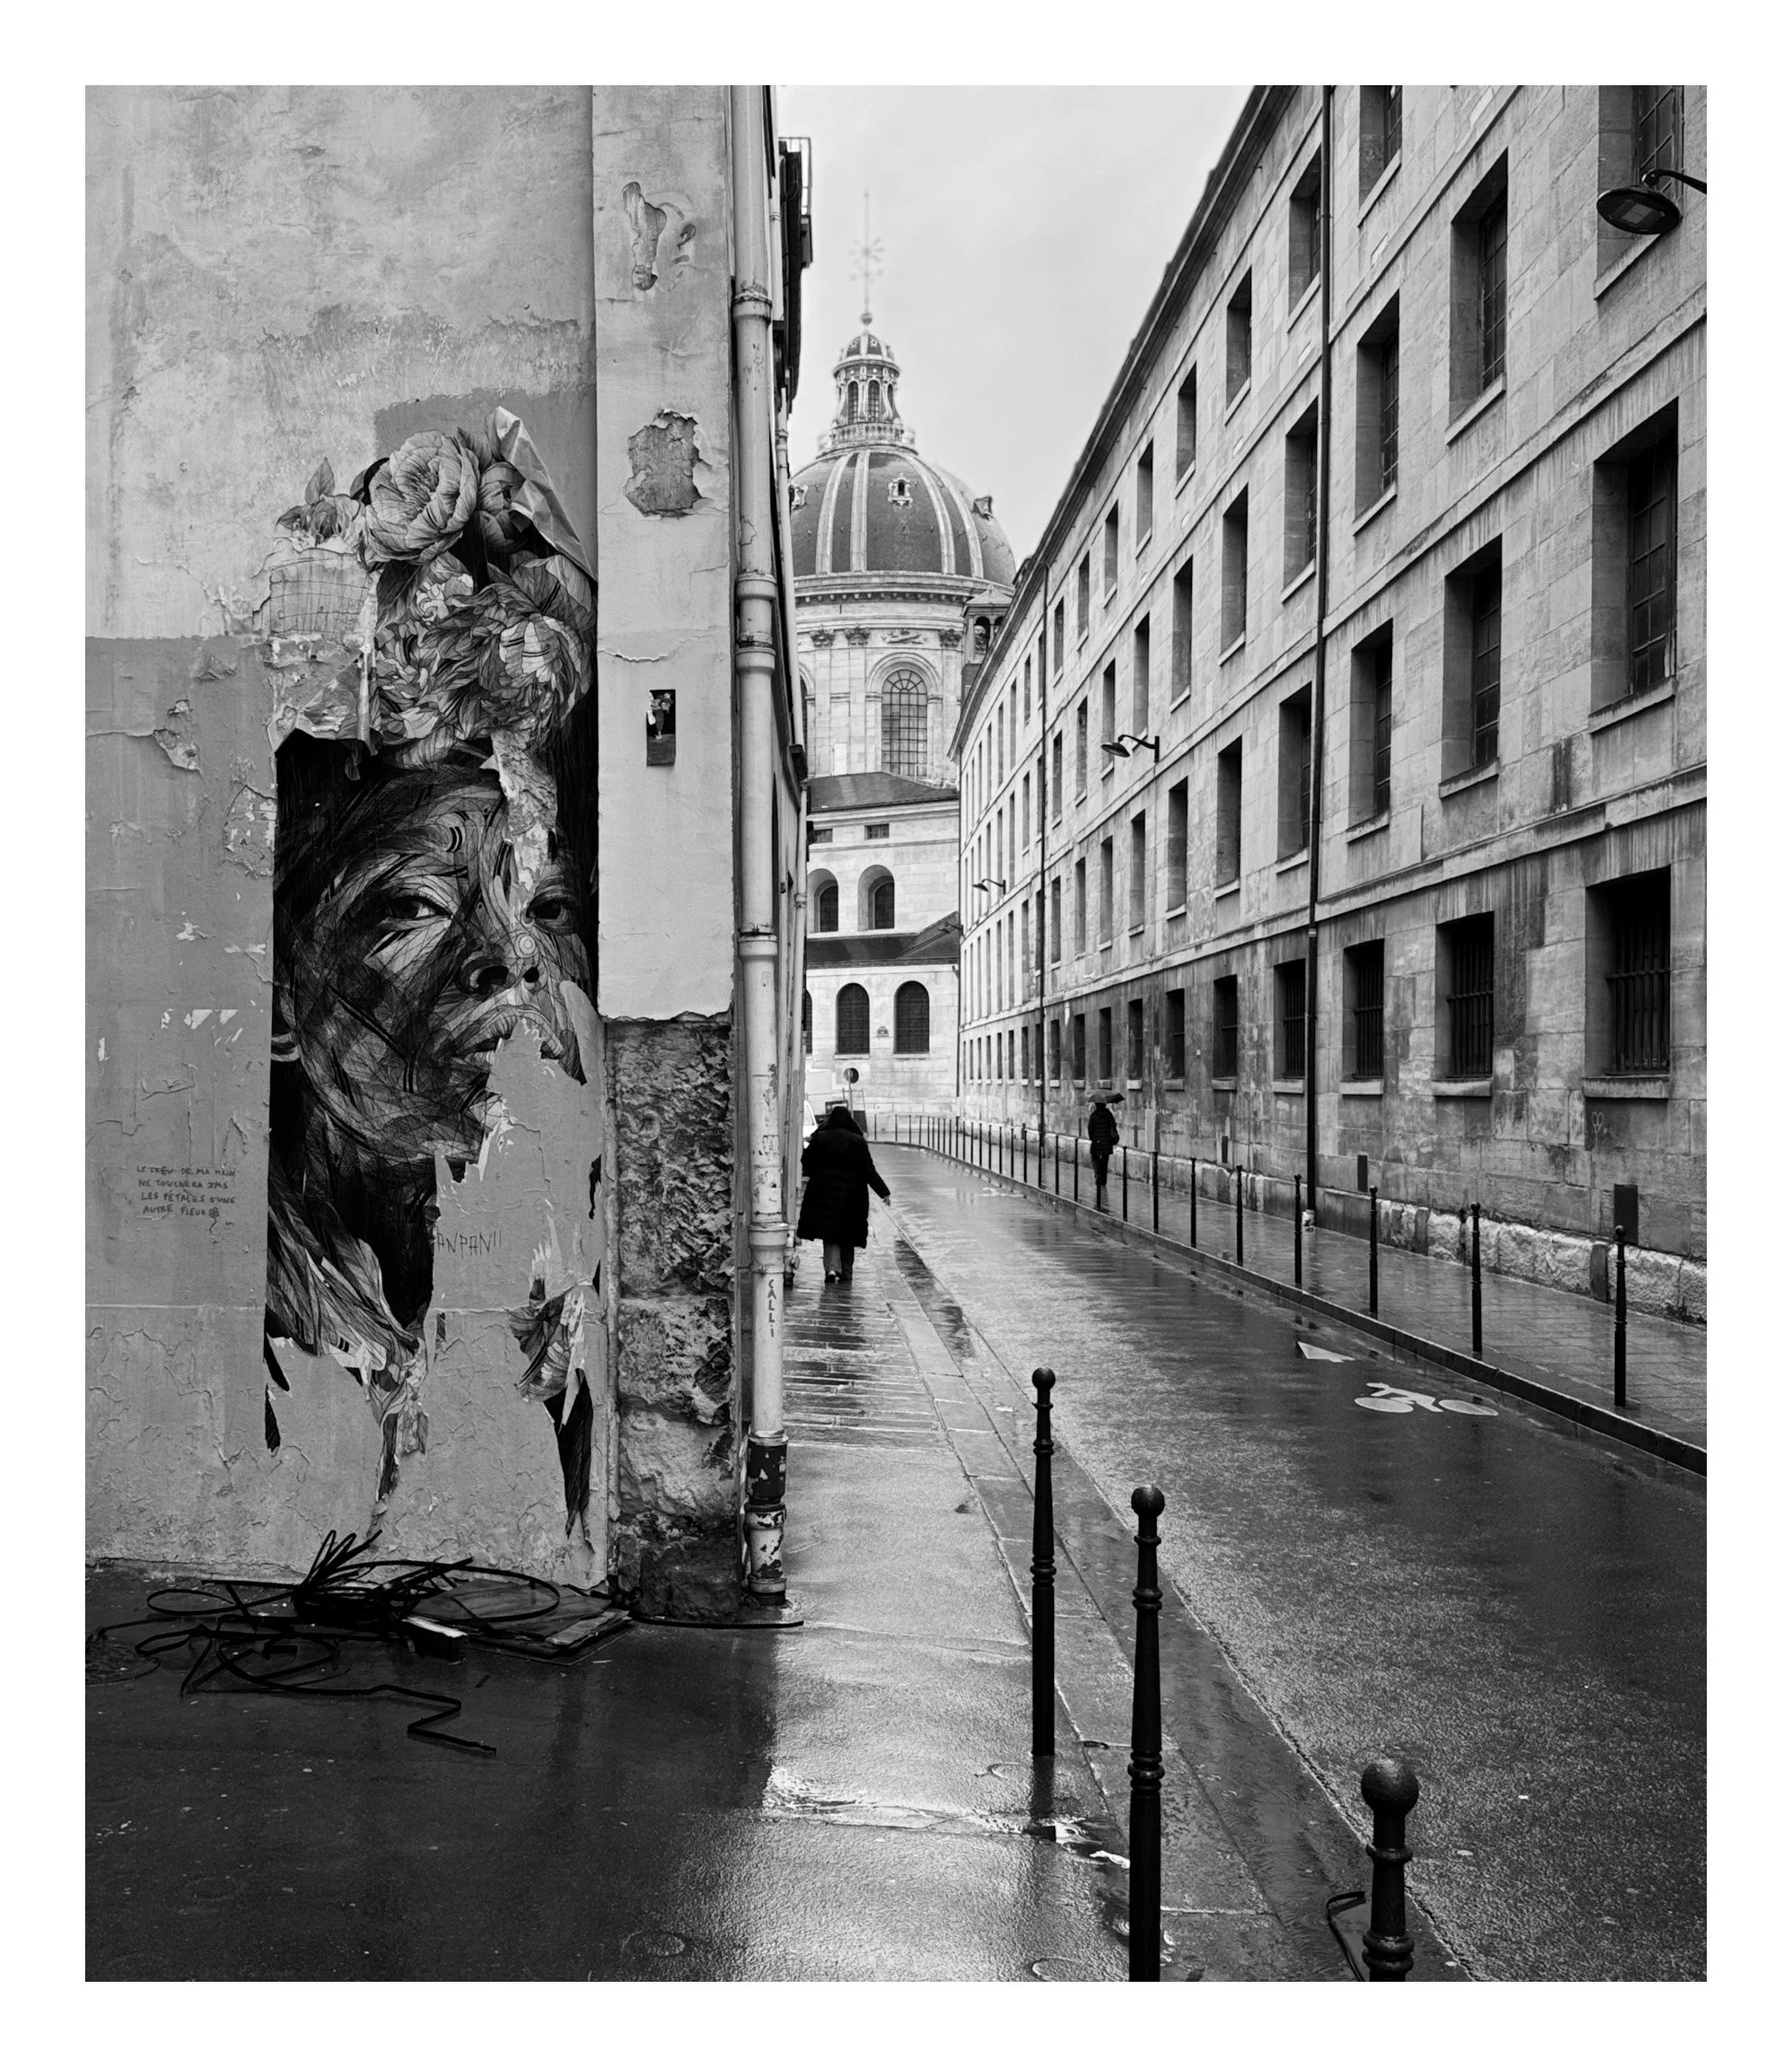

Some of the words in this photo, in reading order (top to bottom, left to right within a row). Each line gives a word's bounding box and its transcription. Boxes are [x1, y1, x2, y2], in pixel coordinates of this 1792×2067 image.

[138, 1179, 151, 1187] NE
[141, 1192, 159, 1201] LES
[143, 1204, 174, 1214] AUTRE
[180, 1207, 207, 1217] FLEUR
